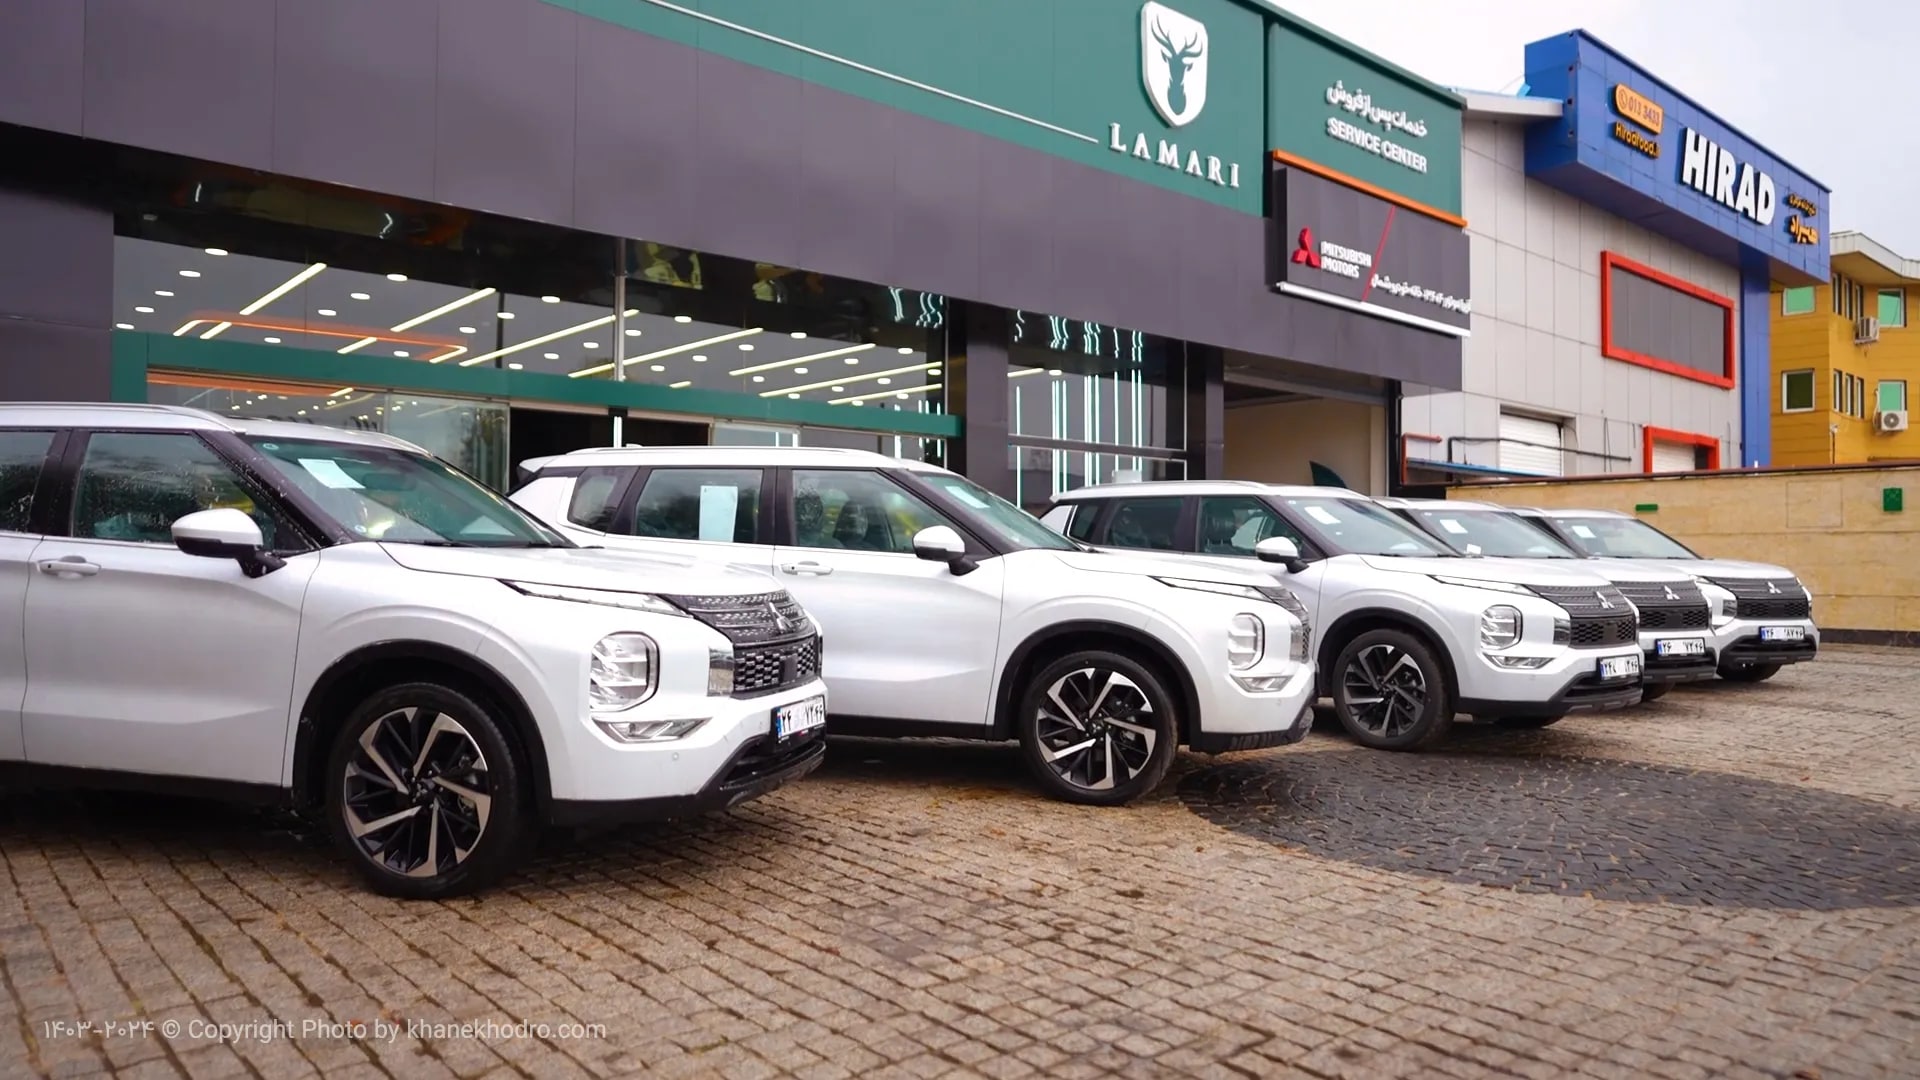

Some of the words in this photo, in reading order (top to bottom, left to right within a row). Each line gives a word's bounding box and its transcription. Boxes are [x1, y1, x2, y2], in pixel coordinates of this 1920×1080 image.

[1326, 79, 1363, 112] فروش
[1370, 105, 1393, 132] پس
[1392, 110, 1428, 138] خدمات
[1109, 121, 1241, 189] LAMARI
[1327, 116, 1381, 154] SERVICE
[1381, 139, 1428, 174] CENTER
[1682, 126, 1776, 226] HIRAD
[1320, 240, 1372, 267] MITSUBISHI
[1320, 256, 1360, 279] MOTORS
